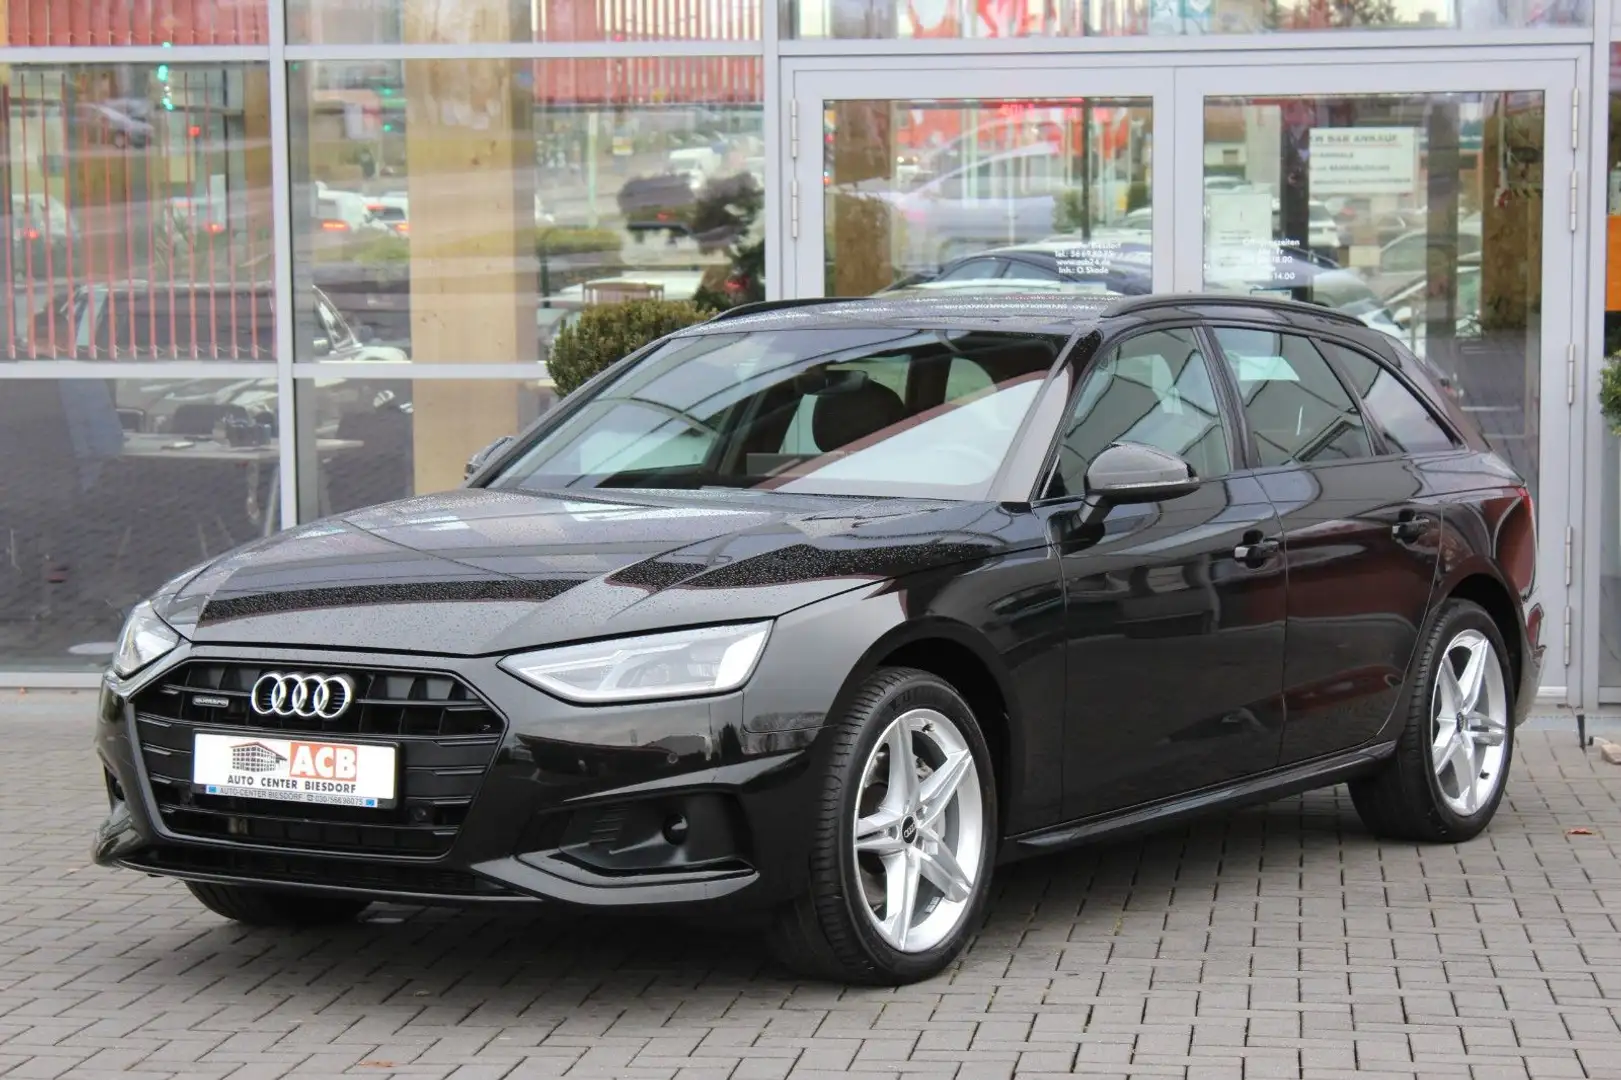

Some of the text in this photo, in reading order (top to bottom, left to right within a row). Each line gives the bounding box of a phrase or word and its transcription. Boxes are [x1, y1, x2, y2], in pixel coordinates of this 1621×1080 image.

[290, 745, 357, 779] ACB
[219, 787, 267, 798] AUTO-CENTER
[268, 791, 303, 800] BIESDORF
[227, 774, 357, 794] AUTO CENTER BIESDORF
